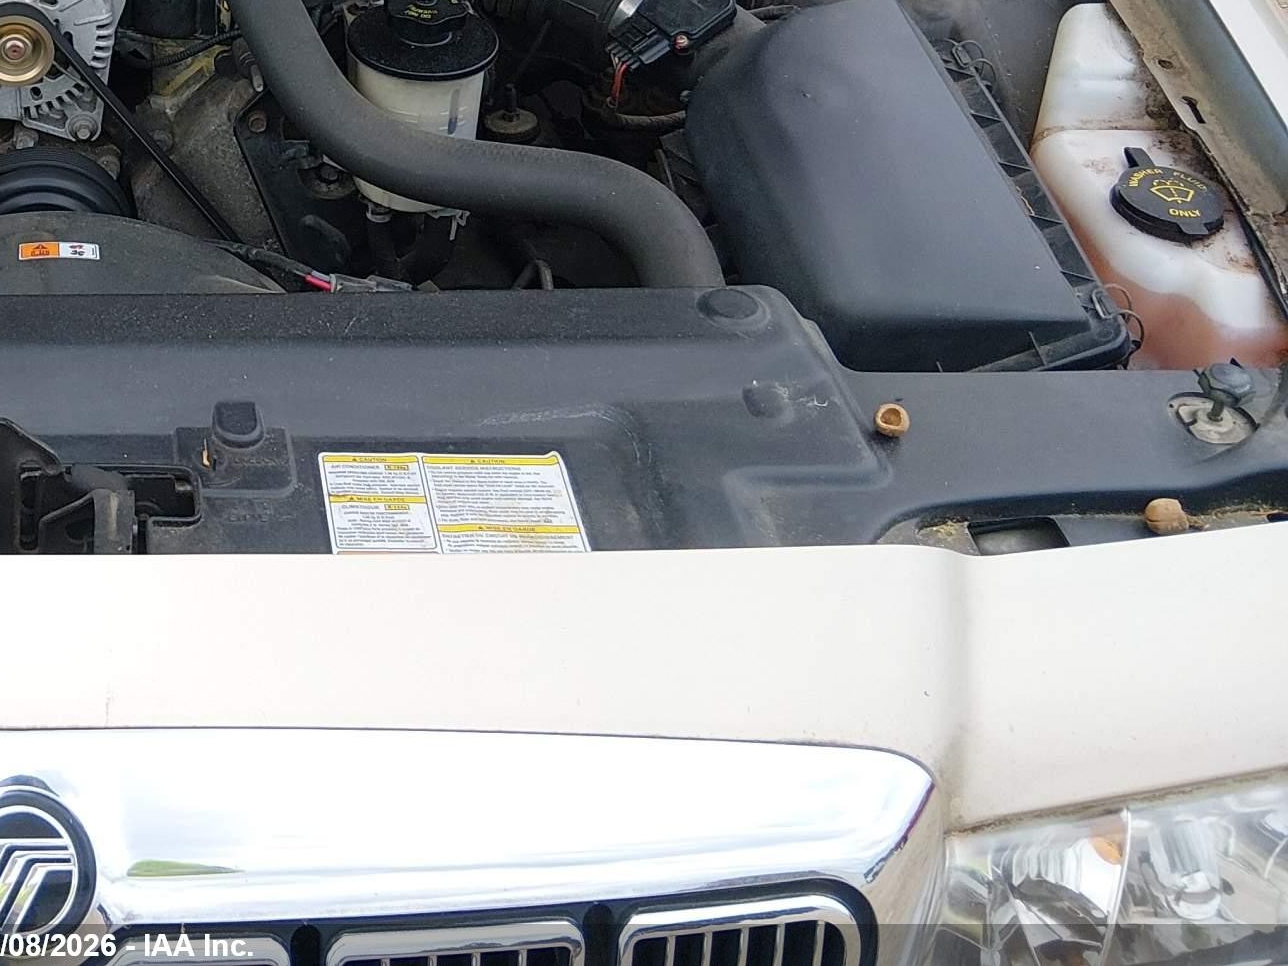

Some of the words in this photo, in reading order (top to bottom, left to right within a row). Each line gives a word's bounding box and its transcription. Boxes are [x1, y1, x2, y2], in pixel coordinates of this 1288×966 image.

[1128, 168, 1164, 187] WASHER
[1173, 171, 1208, 193] FLUID
[1168, 208, 1201, 218] ONLY
